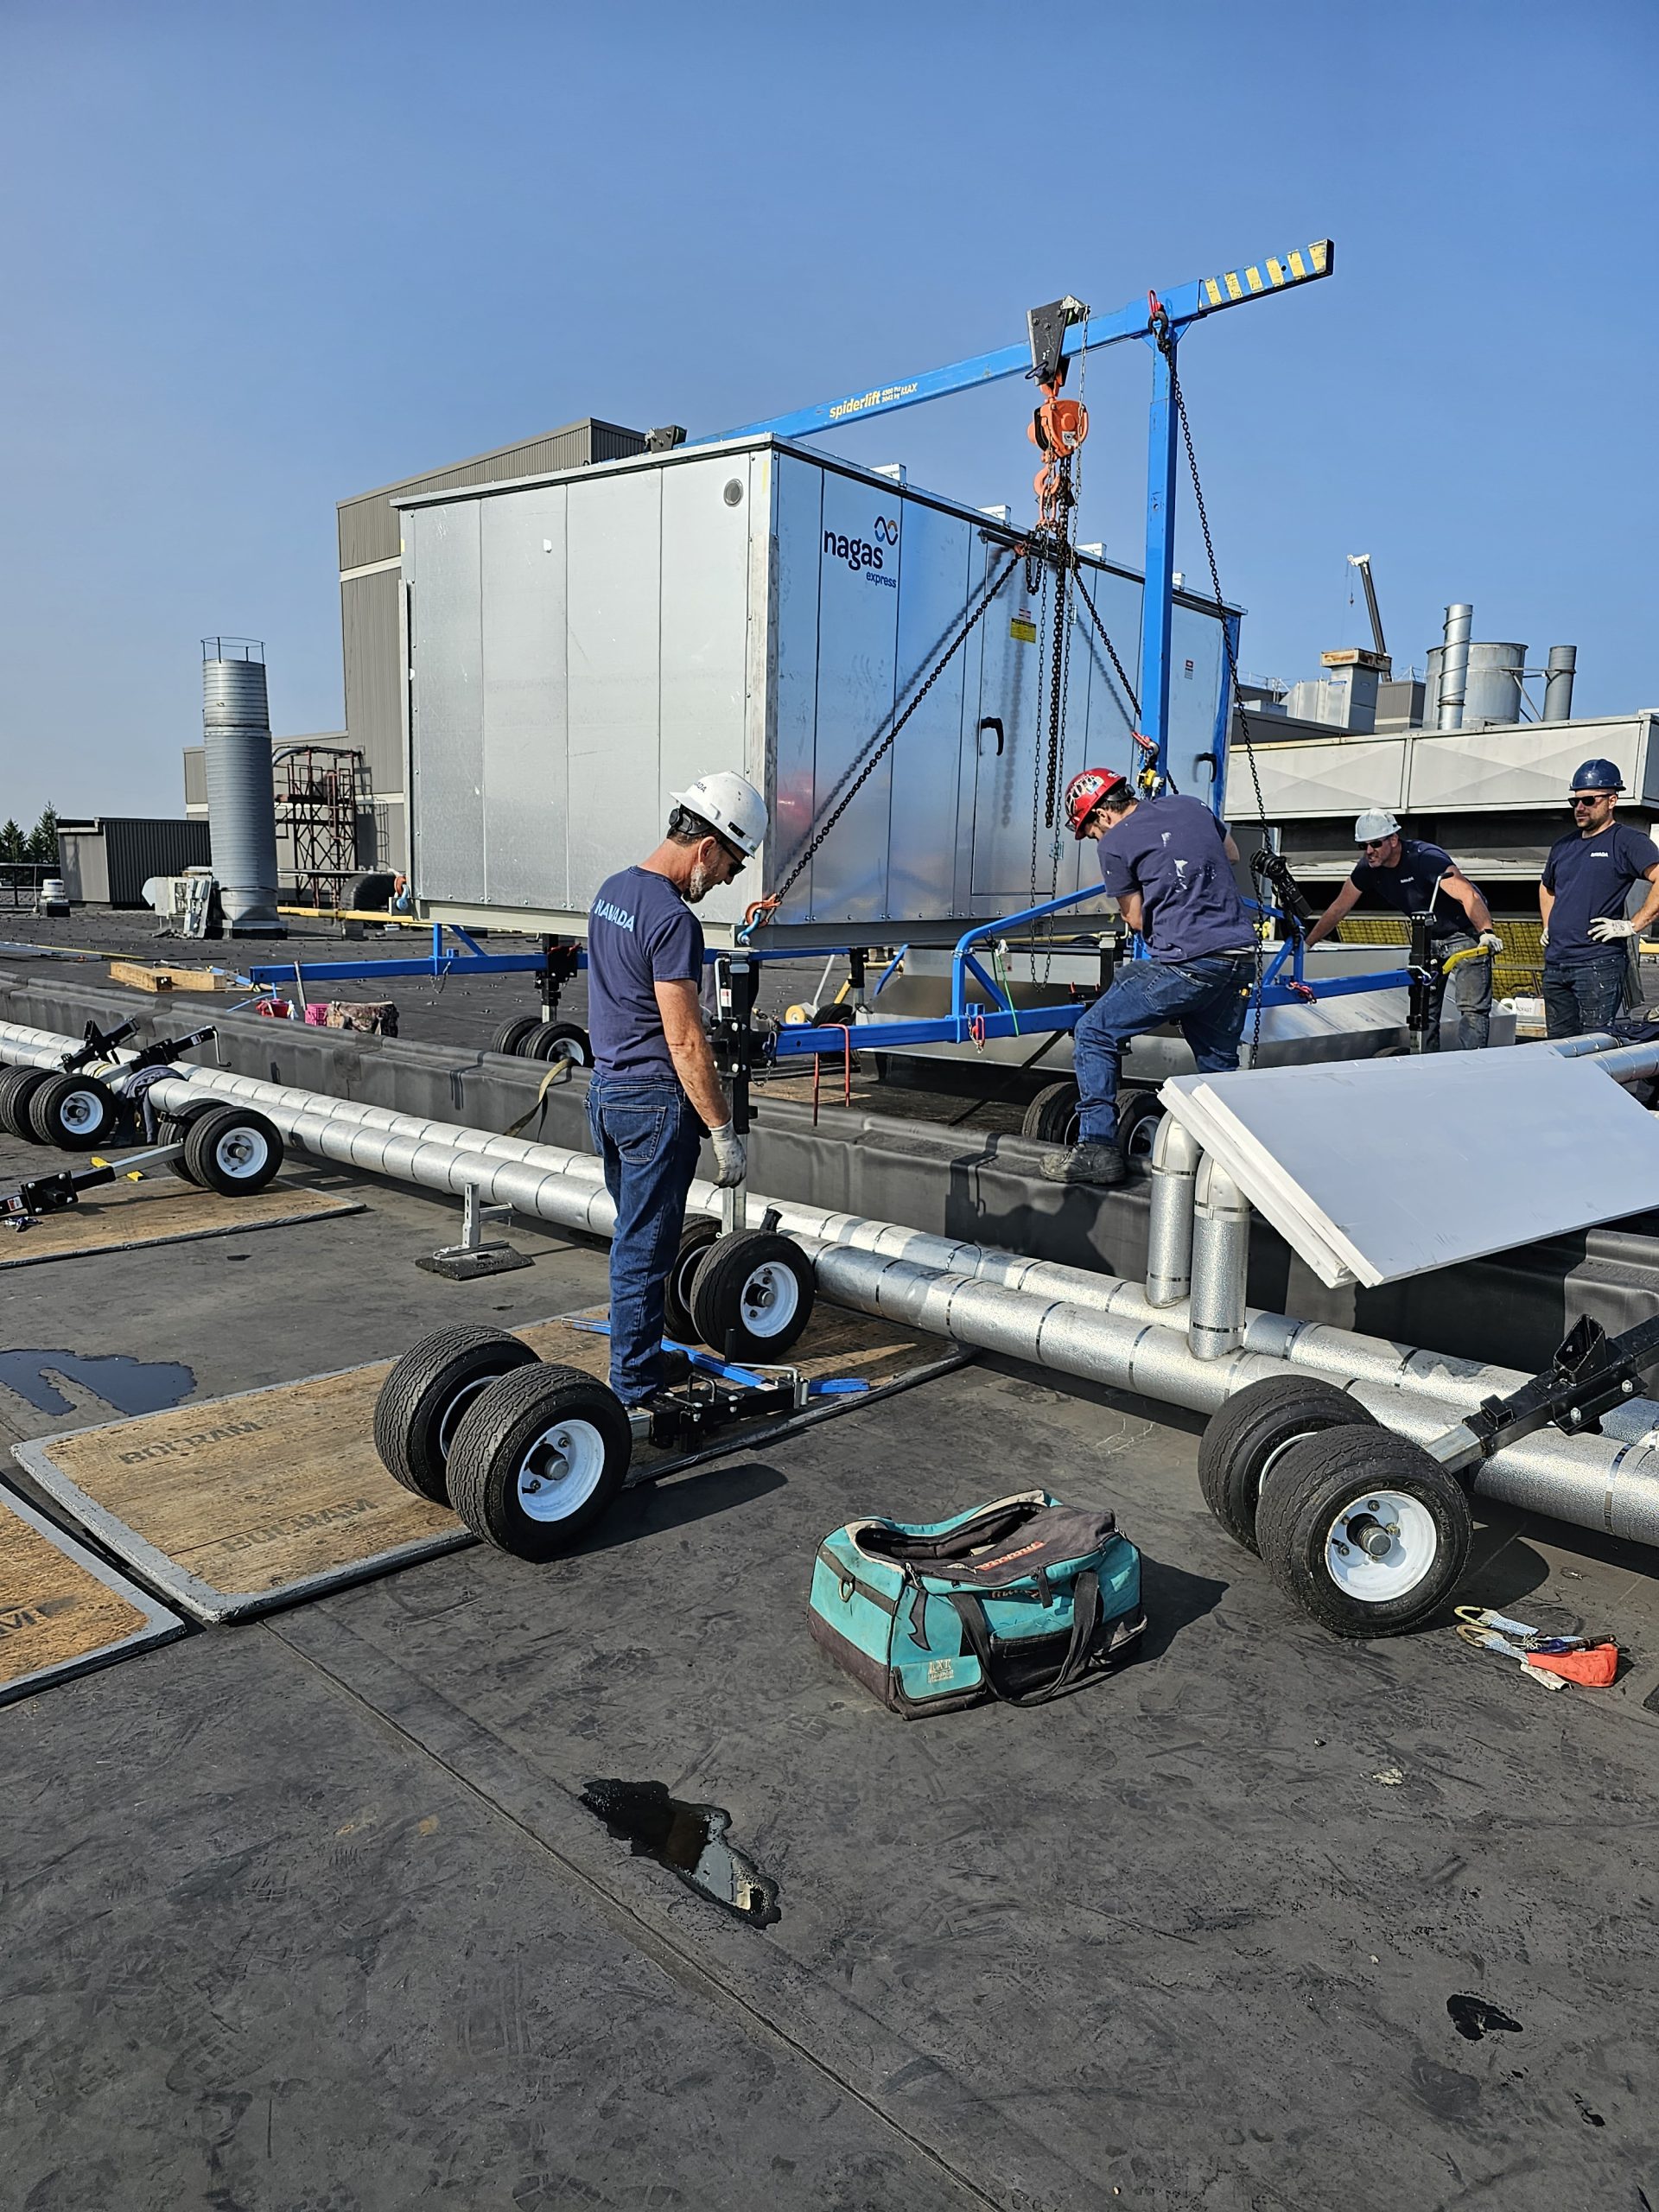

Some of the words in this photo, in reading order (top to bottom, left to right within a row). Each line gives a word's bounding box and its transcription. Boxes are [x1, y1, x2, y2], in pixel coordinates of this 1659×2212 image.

[900, 382, 918, 396] MAX
[830, 390, 881, 420] spiderlift
[823, 530, 883, 571] nagas
[866, 571, 897, 588] express
[594, 899, 635, 932] NAVADA
